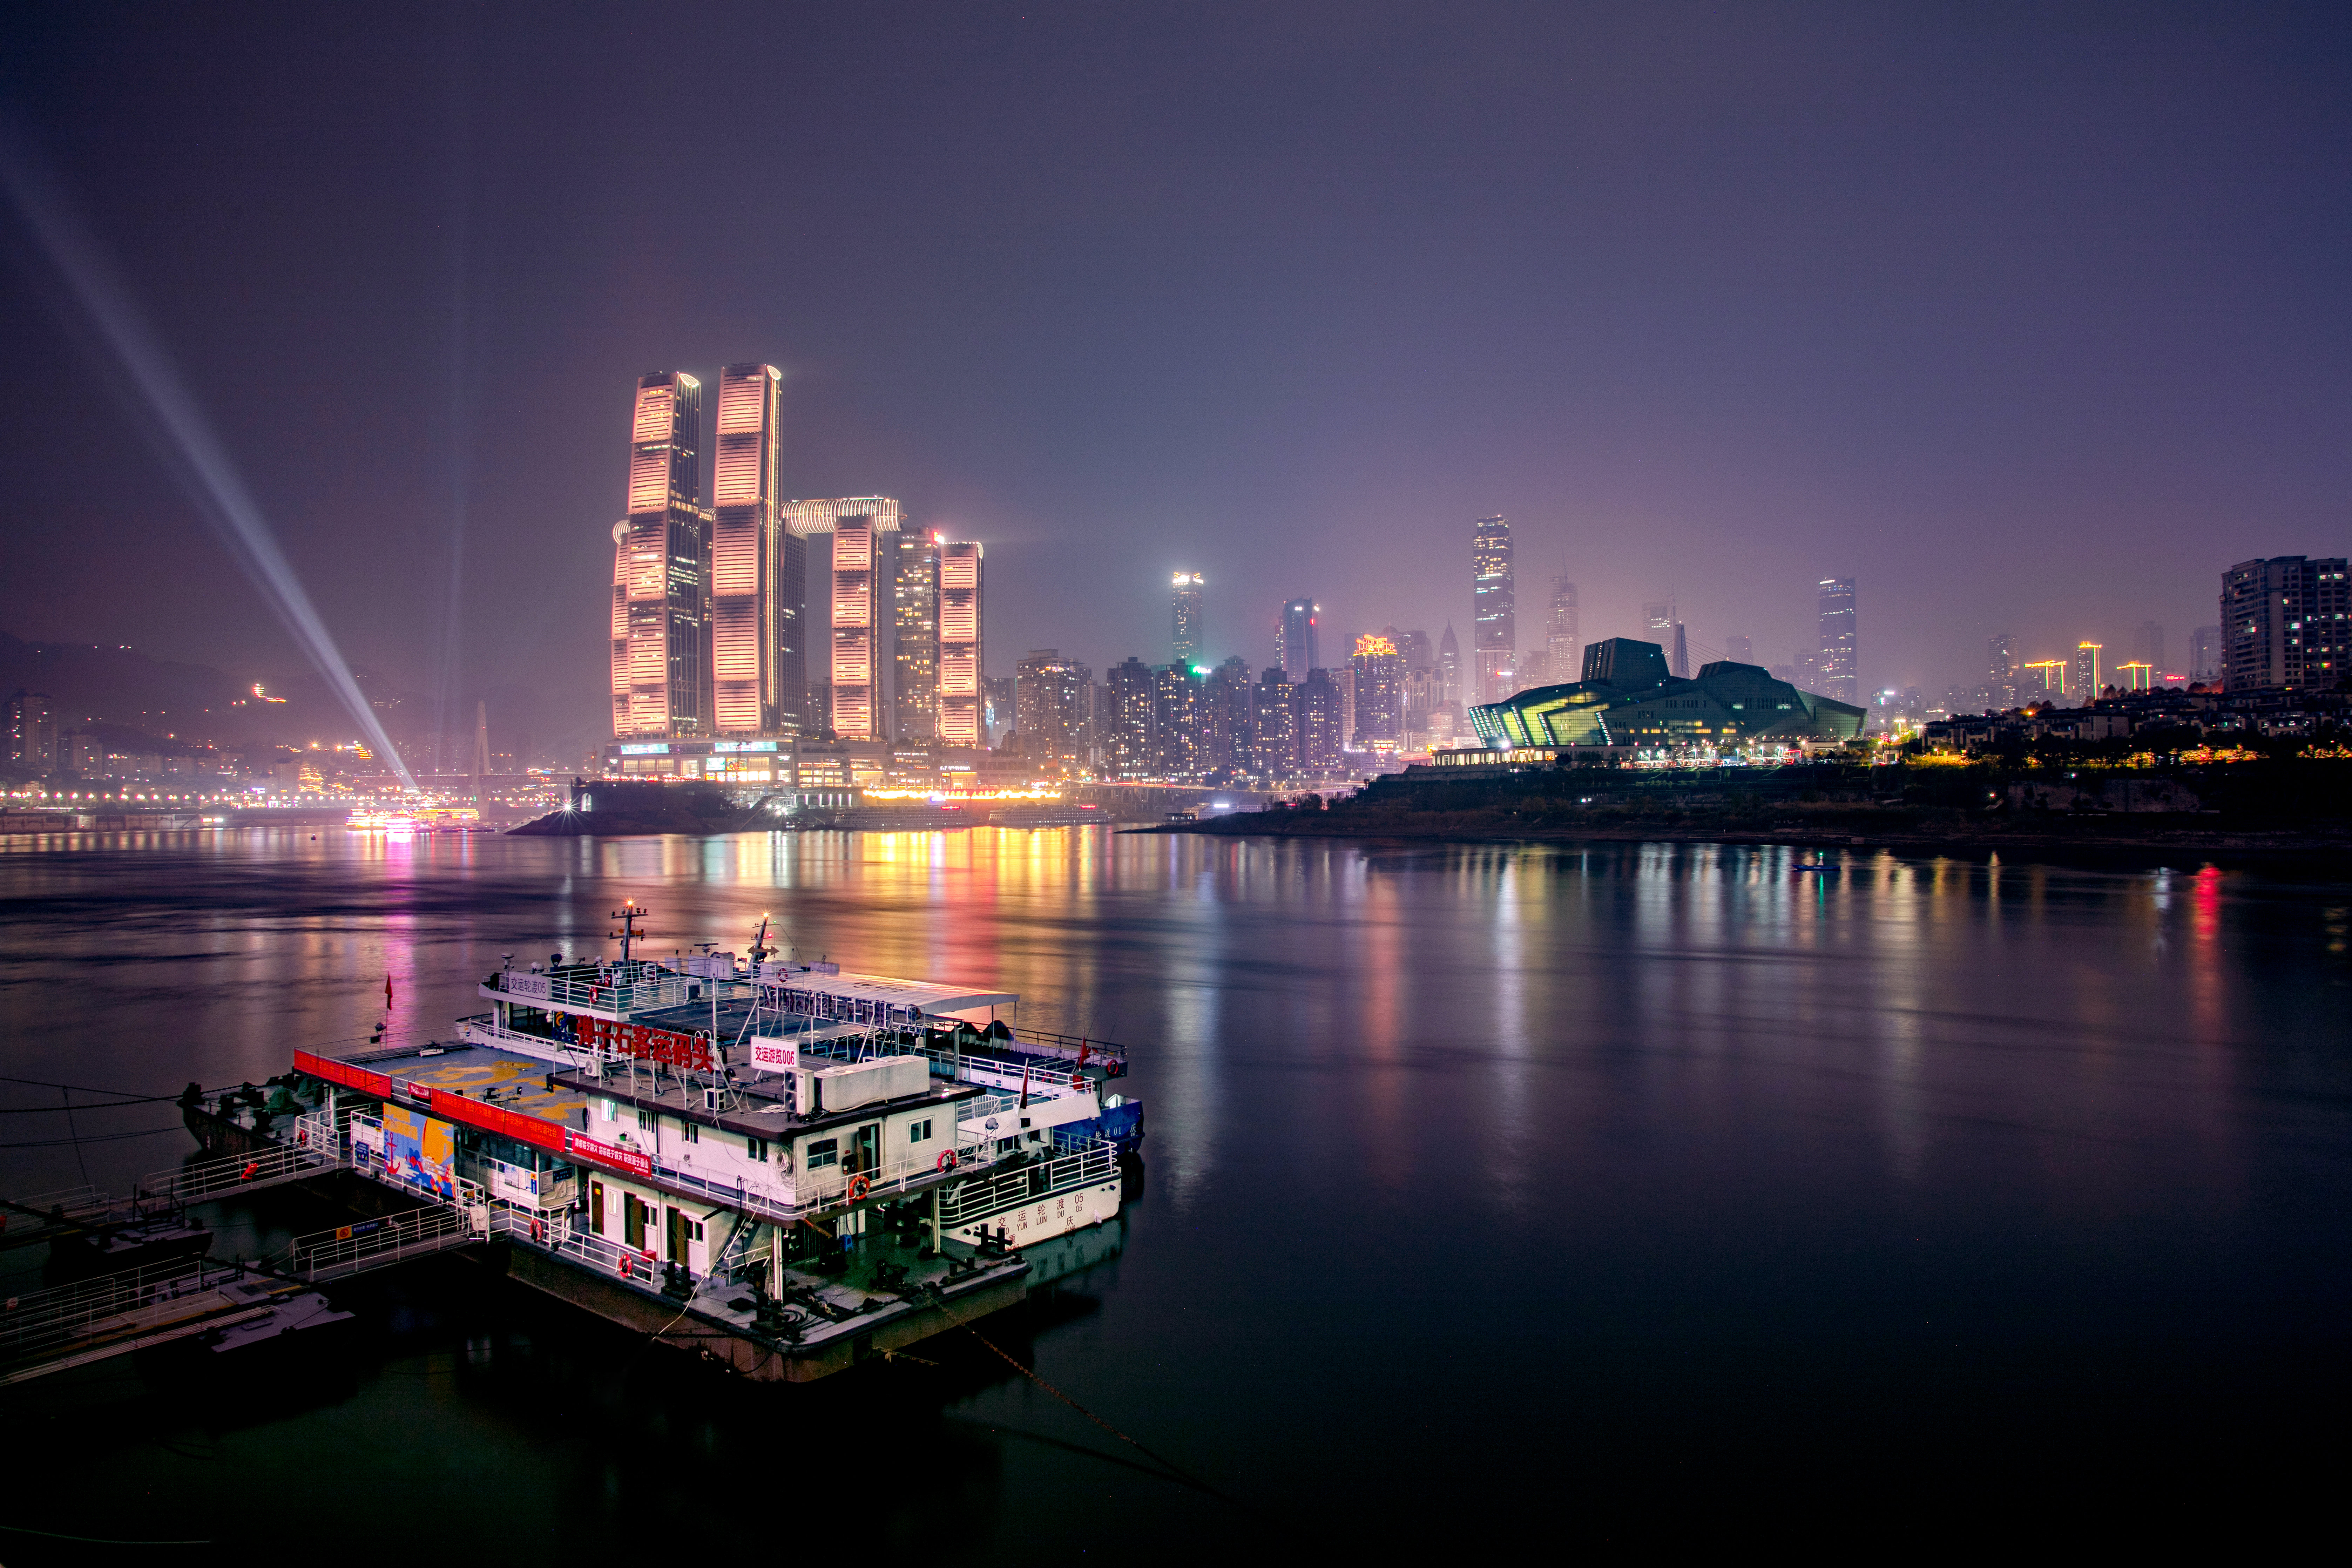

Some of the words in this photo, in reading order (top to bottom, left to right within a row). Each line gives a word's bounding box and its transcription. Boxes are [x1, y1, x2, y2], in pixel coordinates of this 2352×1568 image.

[511, 977, 546, 994] 交运轮渡05
[576, 1014, 715, 1074] 弹子石客运码头
[755, 1046, 795, 1065] 交运游览006
[1017, 1222, 1028, 1231] YUN
[1036, 1215, 1047, 1225] LUN
[1057, 1210, 1065, 1218] DU
[1076, 1204, 1083, 1212] 05
